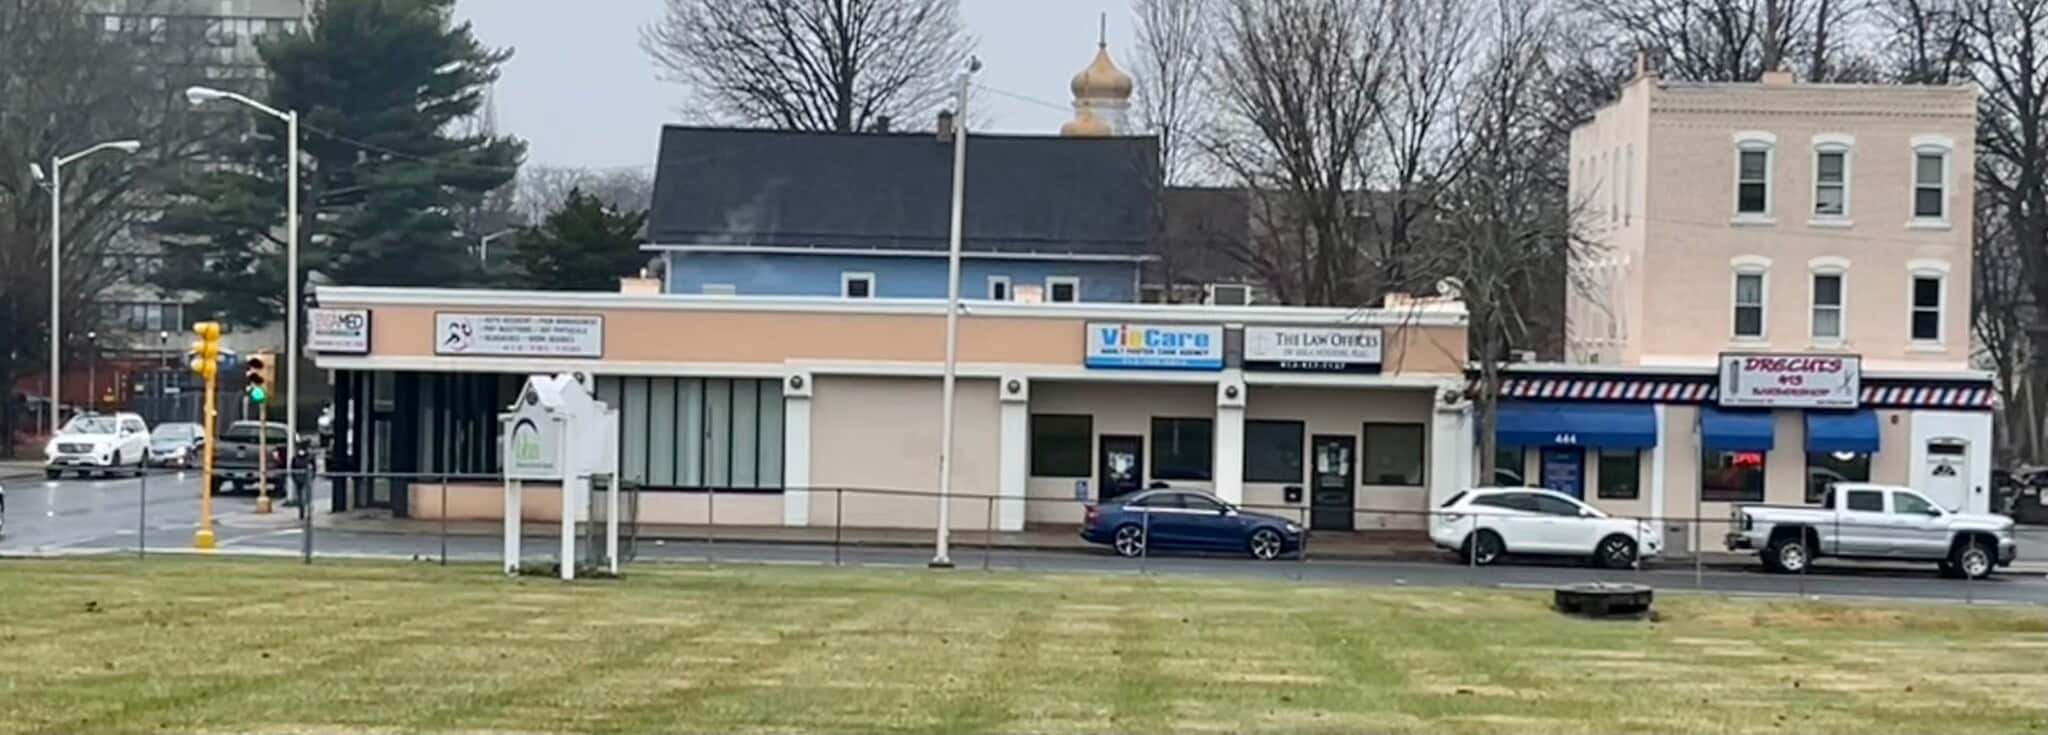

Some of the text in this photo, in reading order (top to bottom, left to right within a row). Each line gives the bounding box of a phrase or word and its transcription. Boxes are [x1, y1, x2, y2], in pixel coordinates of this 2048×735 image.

[1303, 332, 1328, 346] LAW
[1331, 332, 1378, 348] OFFICES
[1554, 433, 1577, 444] 444
